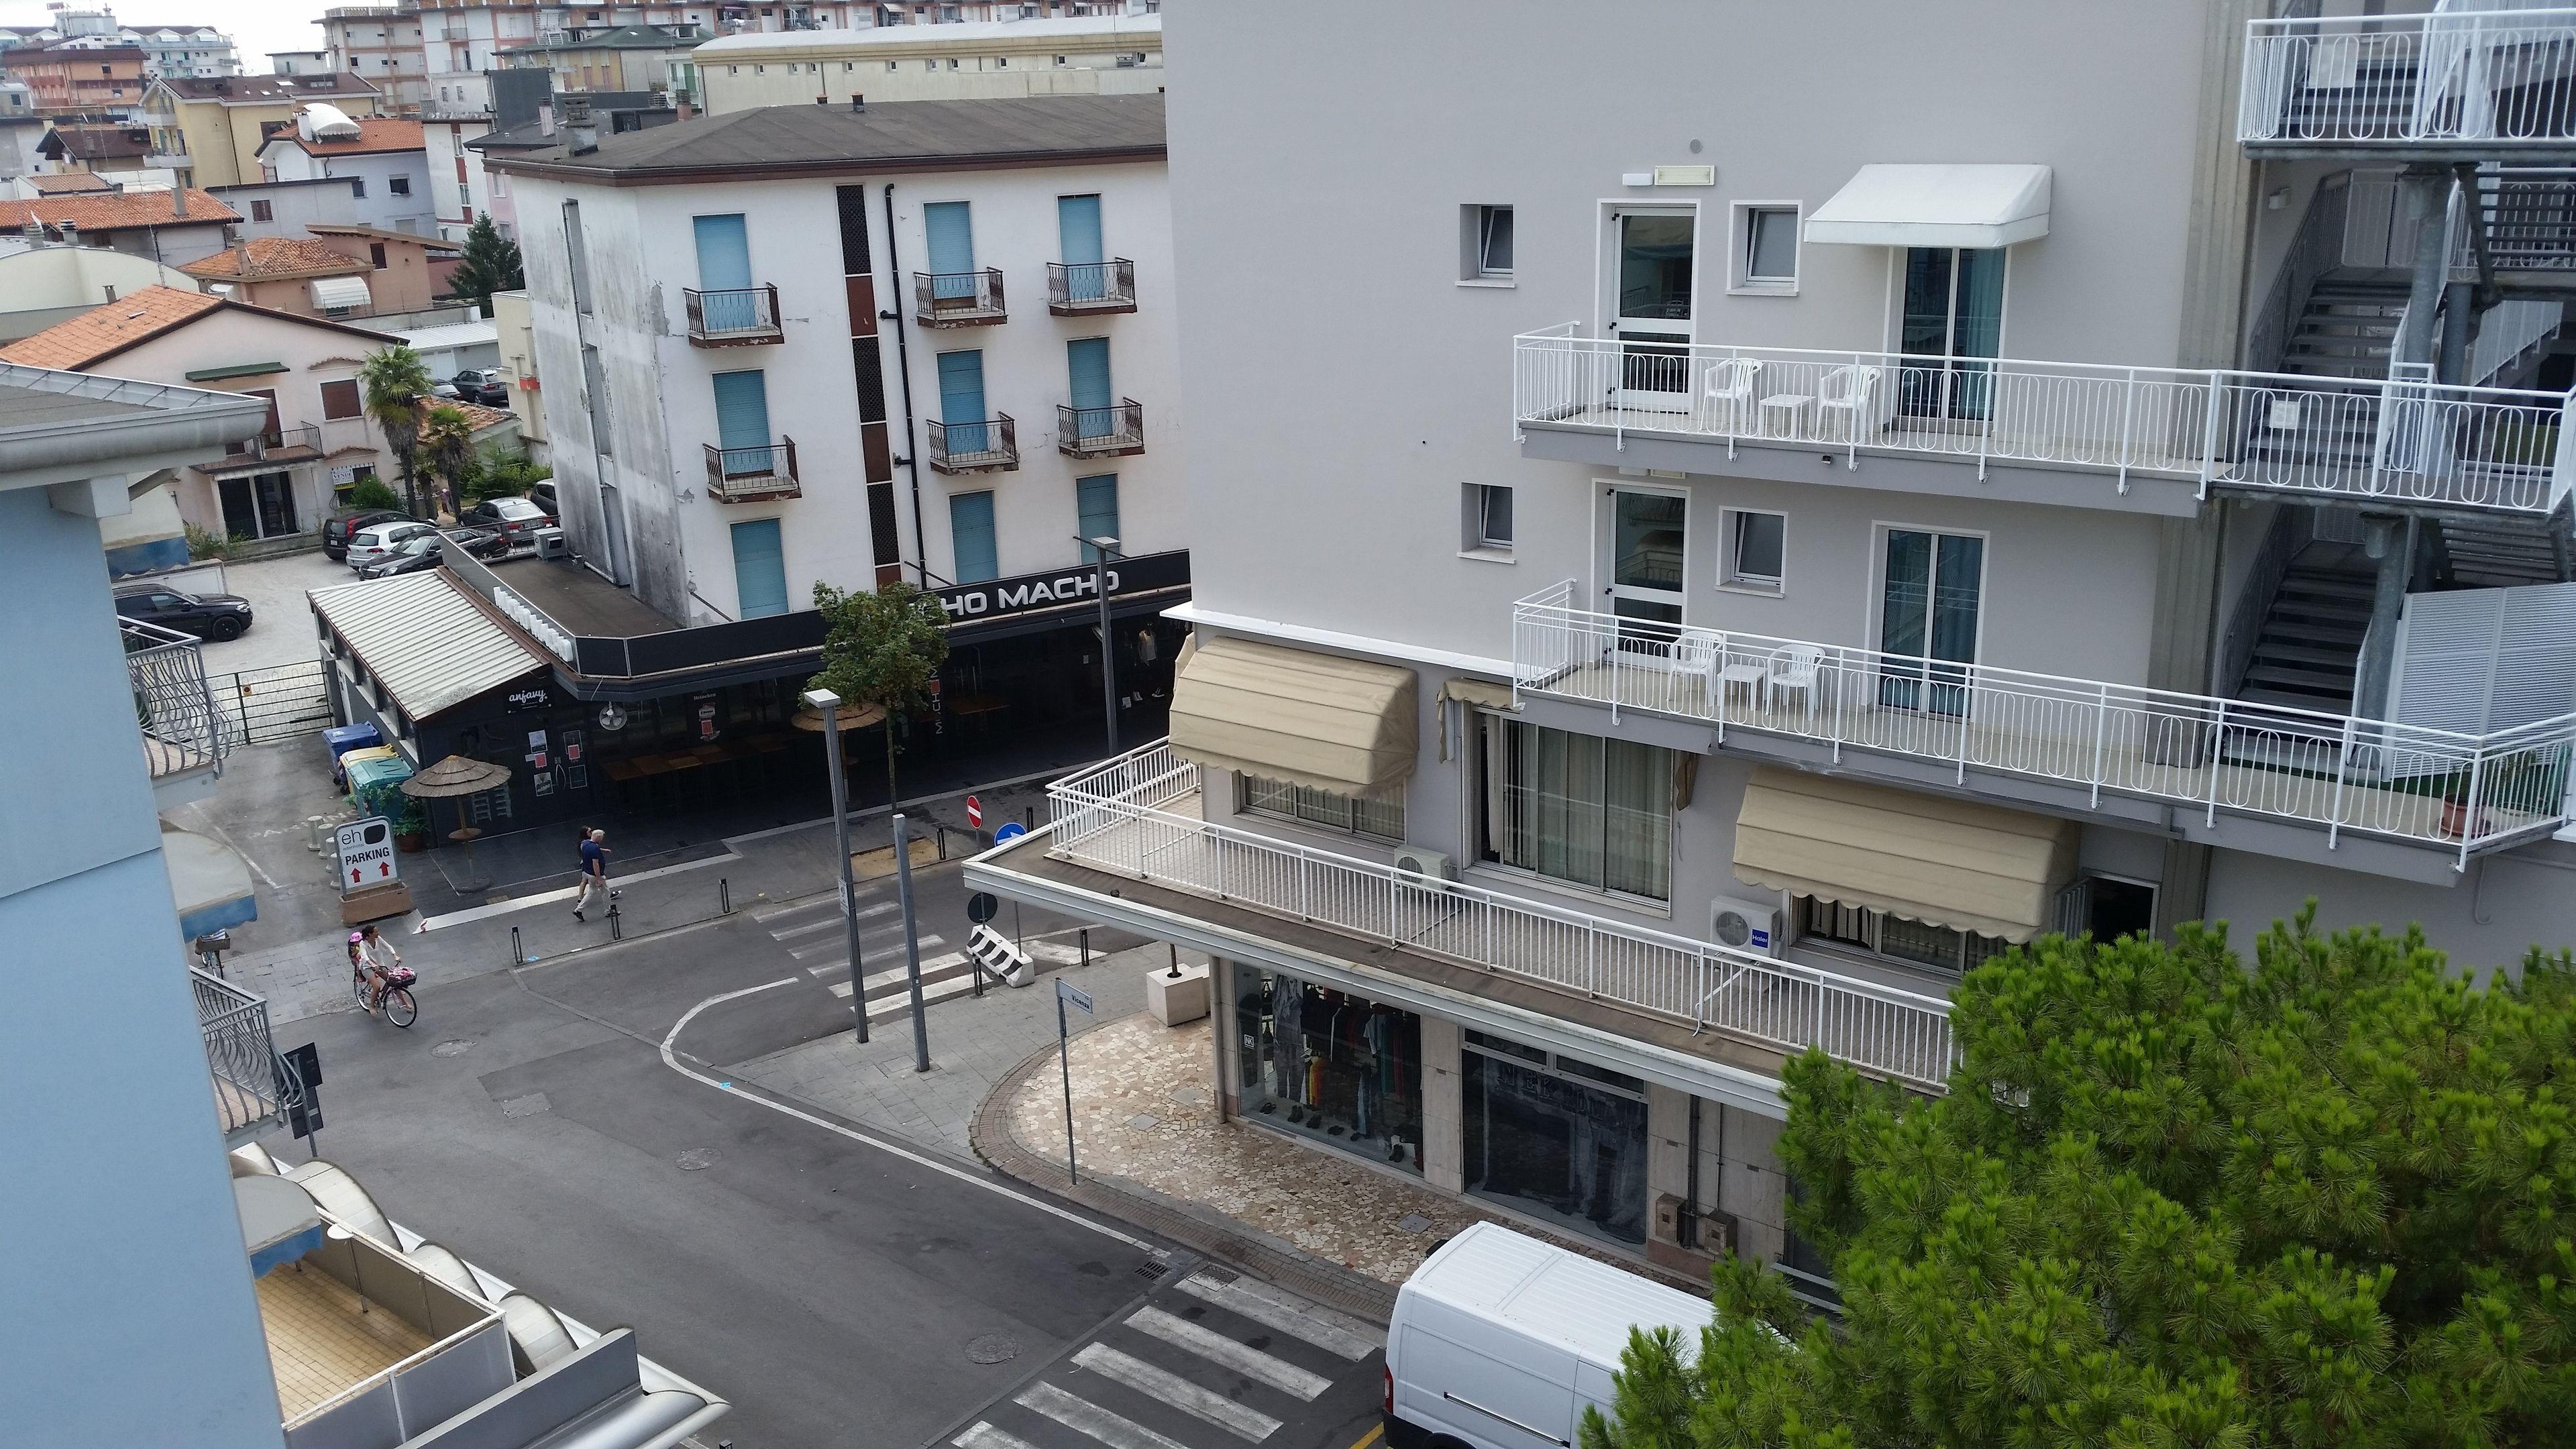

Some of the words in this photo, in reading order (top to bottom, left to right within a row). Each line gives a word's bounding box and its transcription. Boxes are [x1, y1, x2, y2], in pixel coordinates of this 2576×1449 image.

[998, 571, 1119, 608] MACHO
[341, 829, 362, 845] eh
[345, 847, 390, 865] PARKING
[1752, 934, 1768, 943] Haier
[1071, 994, 1090, 1009] Vicenza
